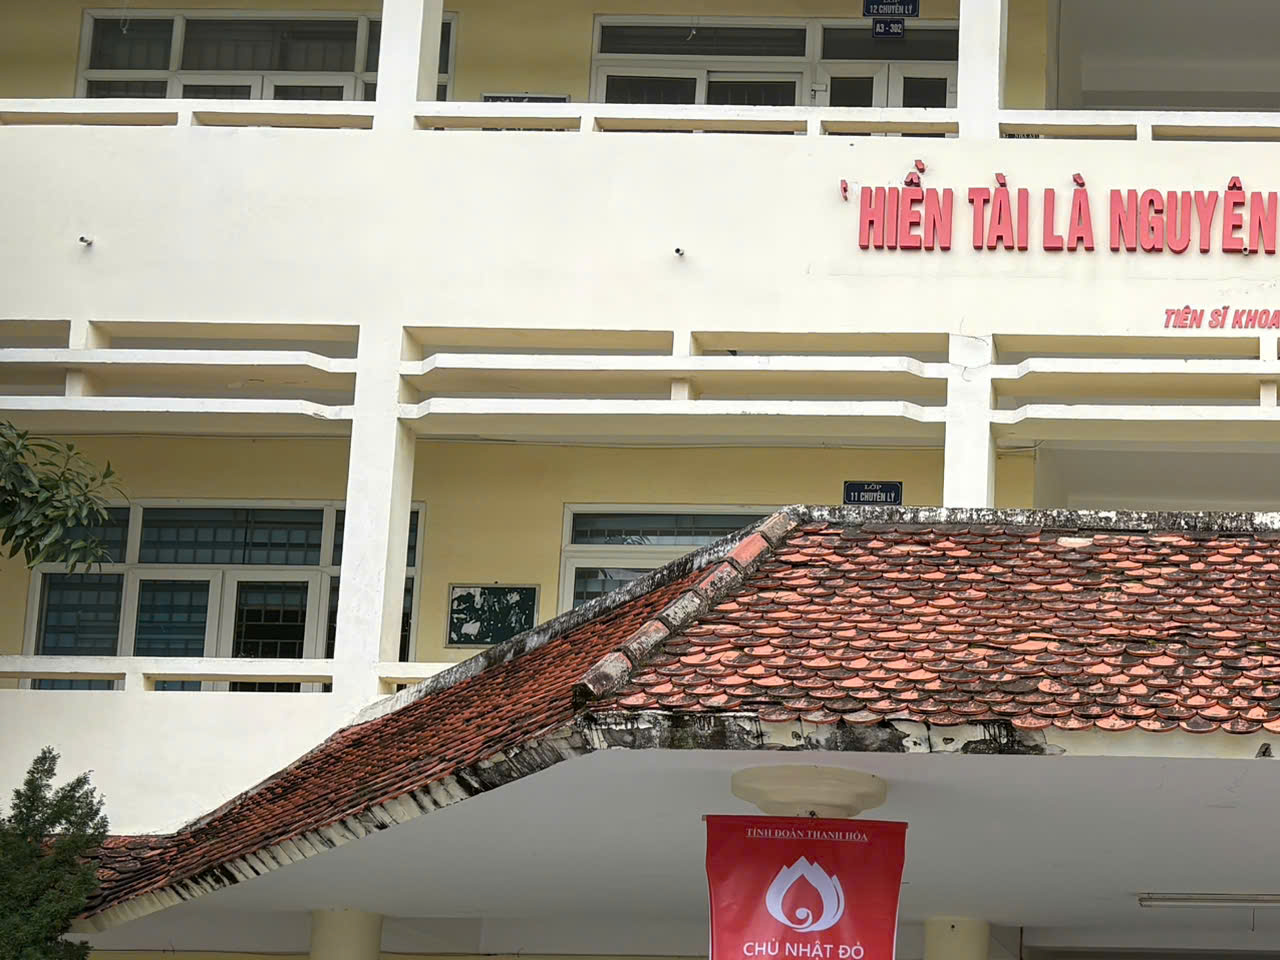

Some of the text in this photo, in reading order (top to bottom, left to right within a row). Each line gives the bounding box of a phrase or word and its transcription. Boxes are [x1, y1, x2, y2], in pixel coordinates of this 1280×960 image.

[870, 5, 878, 14] 12
[875, 24, 885, 33] A3
[968, 172, 1029, 251] TÀI
[1043, 172, 1095, 252] LÀ
[1109, 175, 1279, 254] NGUYÊN
[1208, 305, 1230, 329] SĨ
[1231, 308, 1280, 329] KHOA
[850, 492, 858, 501] 11
[806, 830, 842, 840] THANH
[743, 938, 864, 960] CHỦ NHẬT ĐỎ
